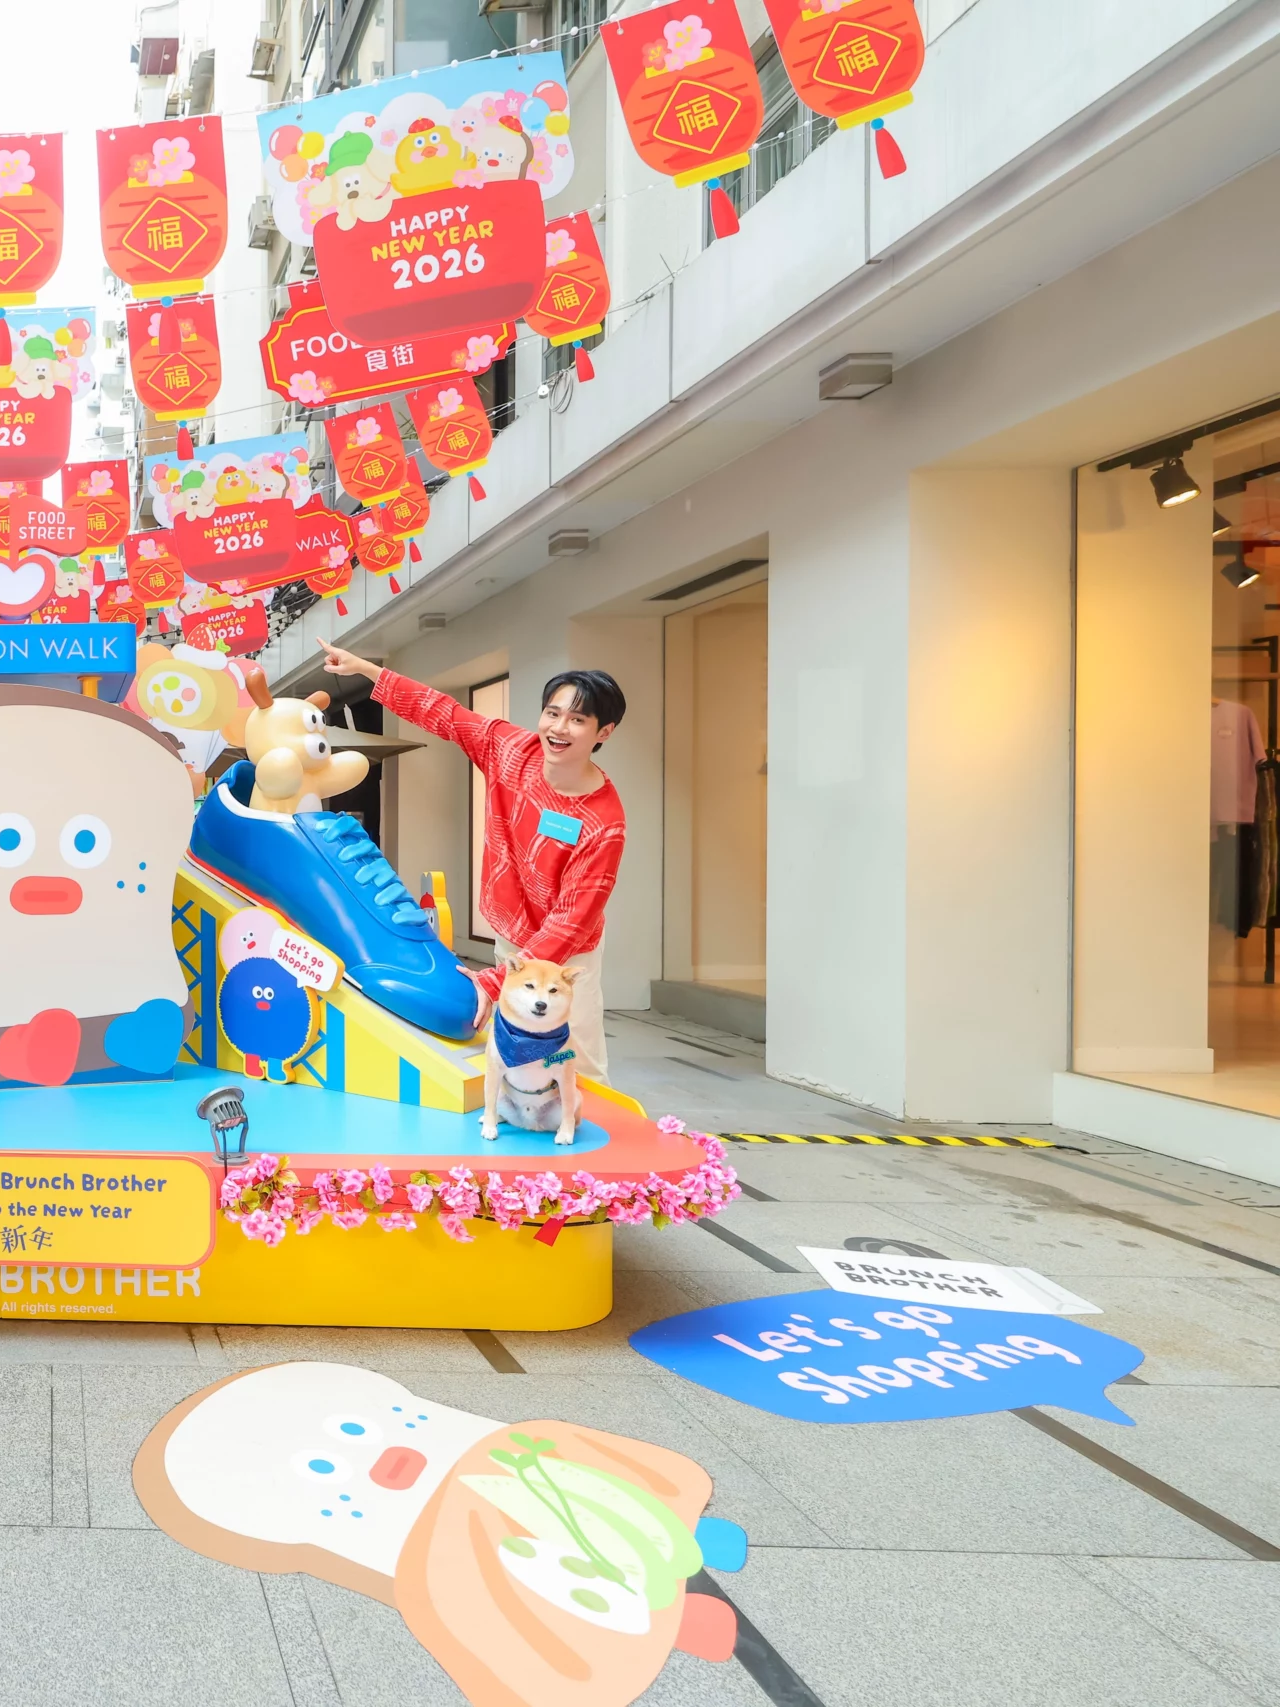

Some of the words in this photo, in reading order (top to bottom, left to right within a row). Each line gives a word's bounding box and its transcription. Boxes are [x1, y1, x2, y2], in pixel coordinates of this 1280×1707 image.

[834, 38, 879, 77] 福
[675, 94, 718, 135] 福
[147, 216, 183, 251] 福
[390, 205, 471, 239] HAPPY
[372, 235, 432, 263] NEW
[433, 218, 493, 246] YEAR
[389, 241, 484, 289] 2026
[551, 283, 580, 311] 福
[291, 332, 363, 361] FOO
[365, 344, 413, 372] 食街
[164, 365, 190, 389] 福
[447, 430, 469, 450] 福
[363, 459, 384, 480] 福
[28, 512, 65, 524] FOOD
[214, 512, 256, 528] HAPPY
[395, 502, 411, 519] 福
[19, 527, 75, 539] STREET
[204, 522, 234, 539] NEW
[236, 518, 268, 532] YEAR
[296, 529, 343, 552] WALK
[214, 533, 263, 553] 2026
[149, 572, 165, 588] 福
[207, 610, 237, 623] HAPPY
[223, 615, 247, 627] YEAR
[40, 637, 117, 659] WALK
[284, 939, 309, 961] Let's
[311, 957, 323, 967] go
[277, 947, 322, 984] Shopping
[1, 1172, 74, 1190] Brunch
[82, 1174, 167, 1192] Brother
[8, 1202, 37, 1216] the
[44, 1204, 83, 1217] New
[90, 1205, 132, 1218] Year
[0, 1264, 202, 1298] BROTHER
[834, 1259, 990, 1288] BRUNCH
[844, 1272, 1004, 1299] BROTHER
[1, 1302, 16, 1311] All
[21, 1302, 56, 1314] rights
[60, 1304, 114, 1314] reserved.
[712, 1313, 883, 1363] Let's
[873, 1305, 954, 1339] go
[777, 1333, 1083, 1405] Shopping
